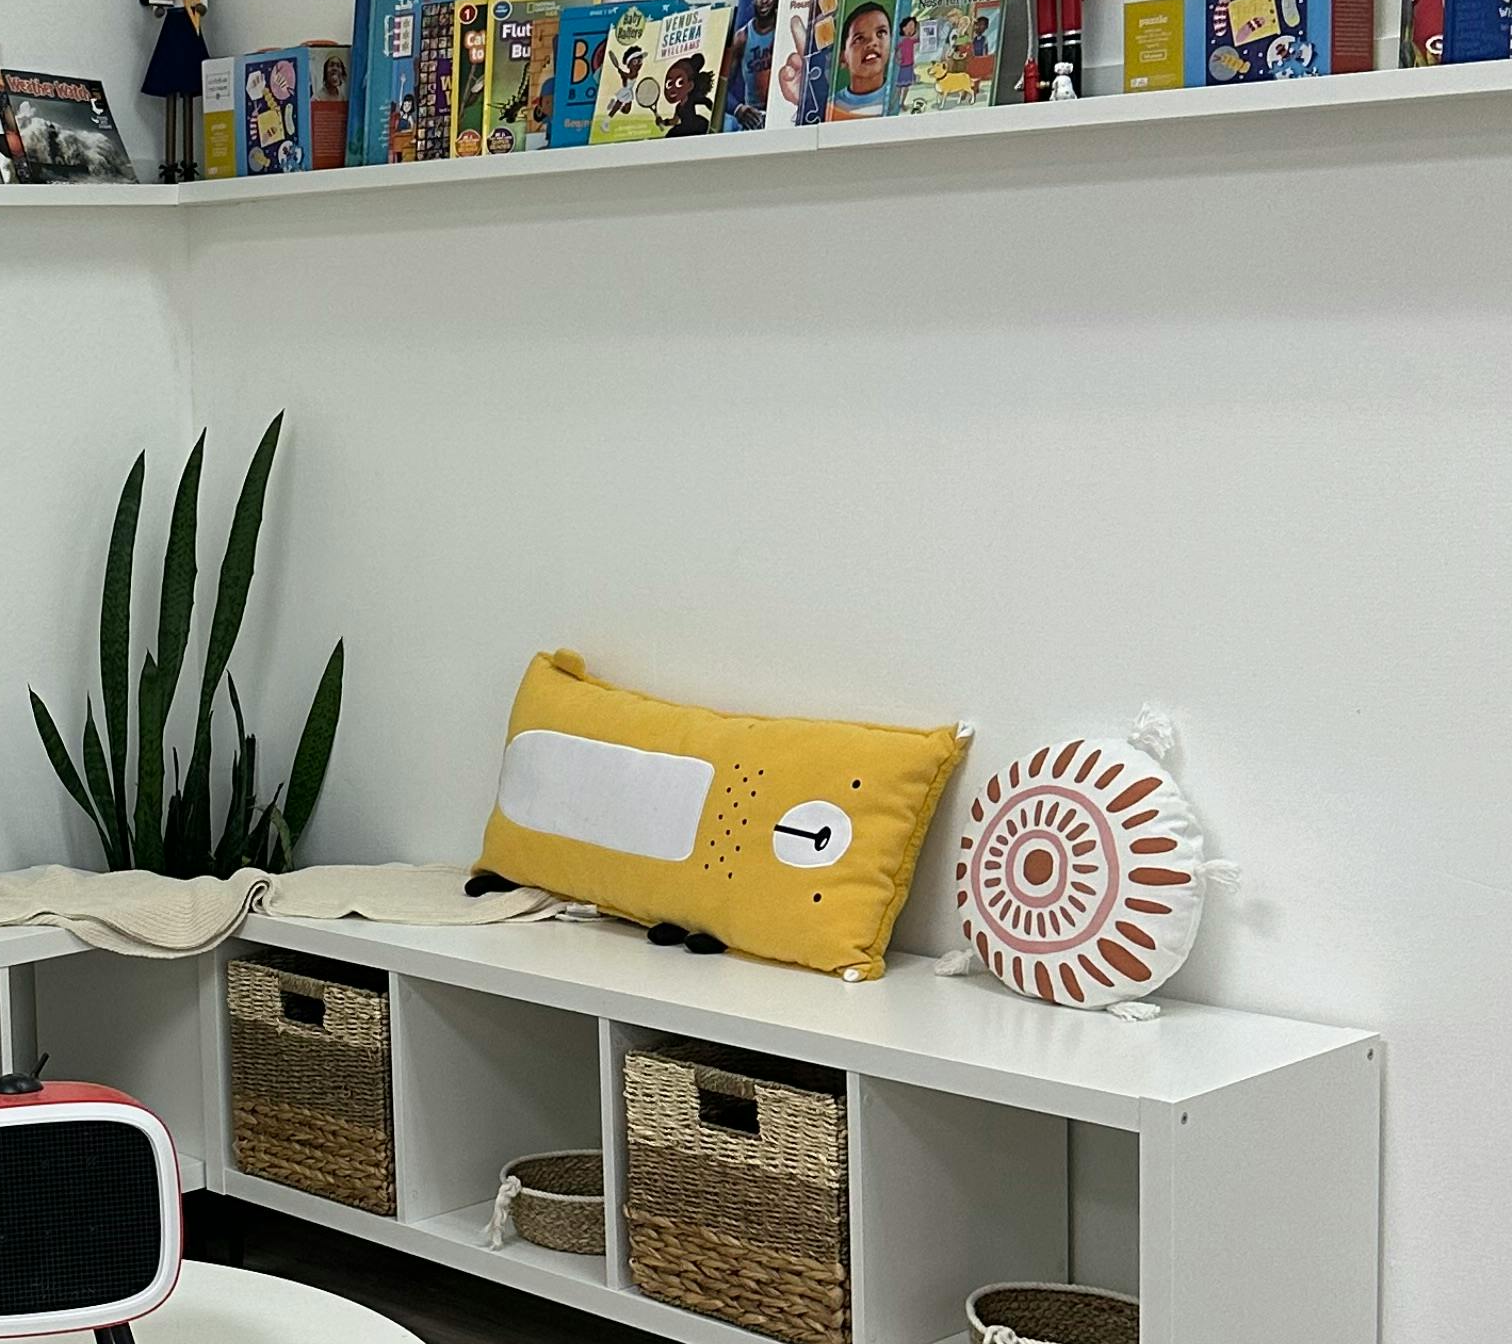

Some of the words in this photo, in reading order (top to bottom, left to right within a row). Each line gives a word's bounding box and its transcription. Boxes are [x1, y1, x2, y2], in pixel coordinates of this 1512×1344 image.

[464, 9, 471, 21] 1
[665, 11, 699, 33] VENUS
[662, 25, 702, 48] SERENA
[661, 39, 702, 57] WILLIAMS
[5, 73, 56, 98] Weather
